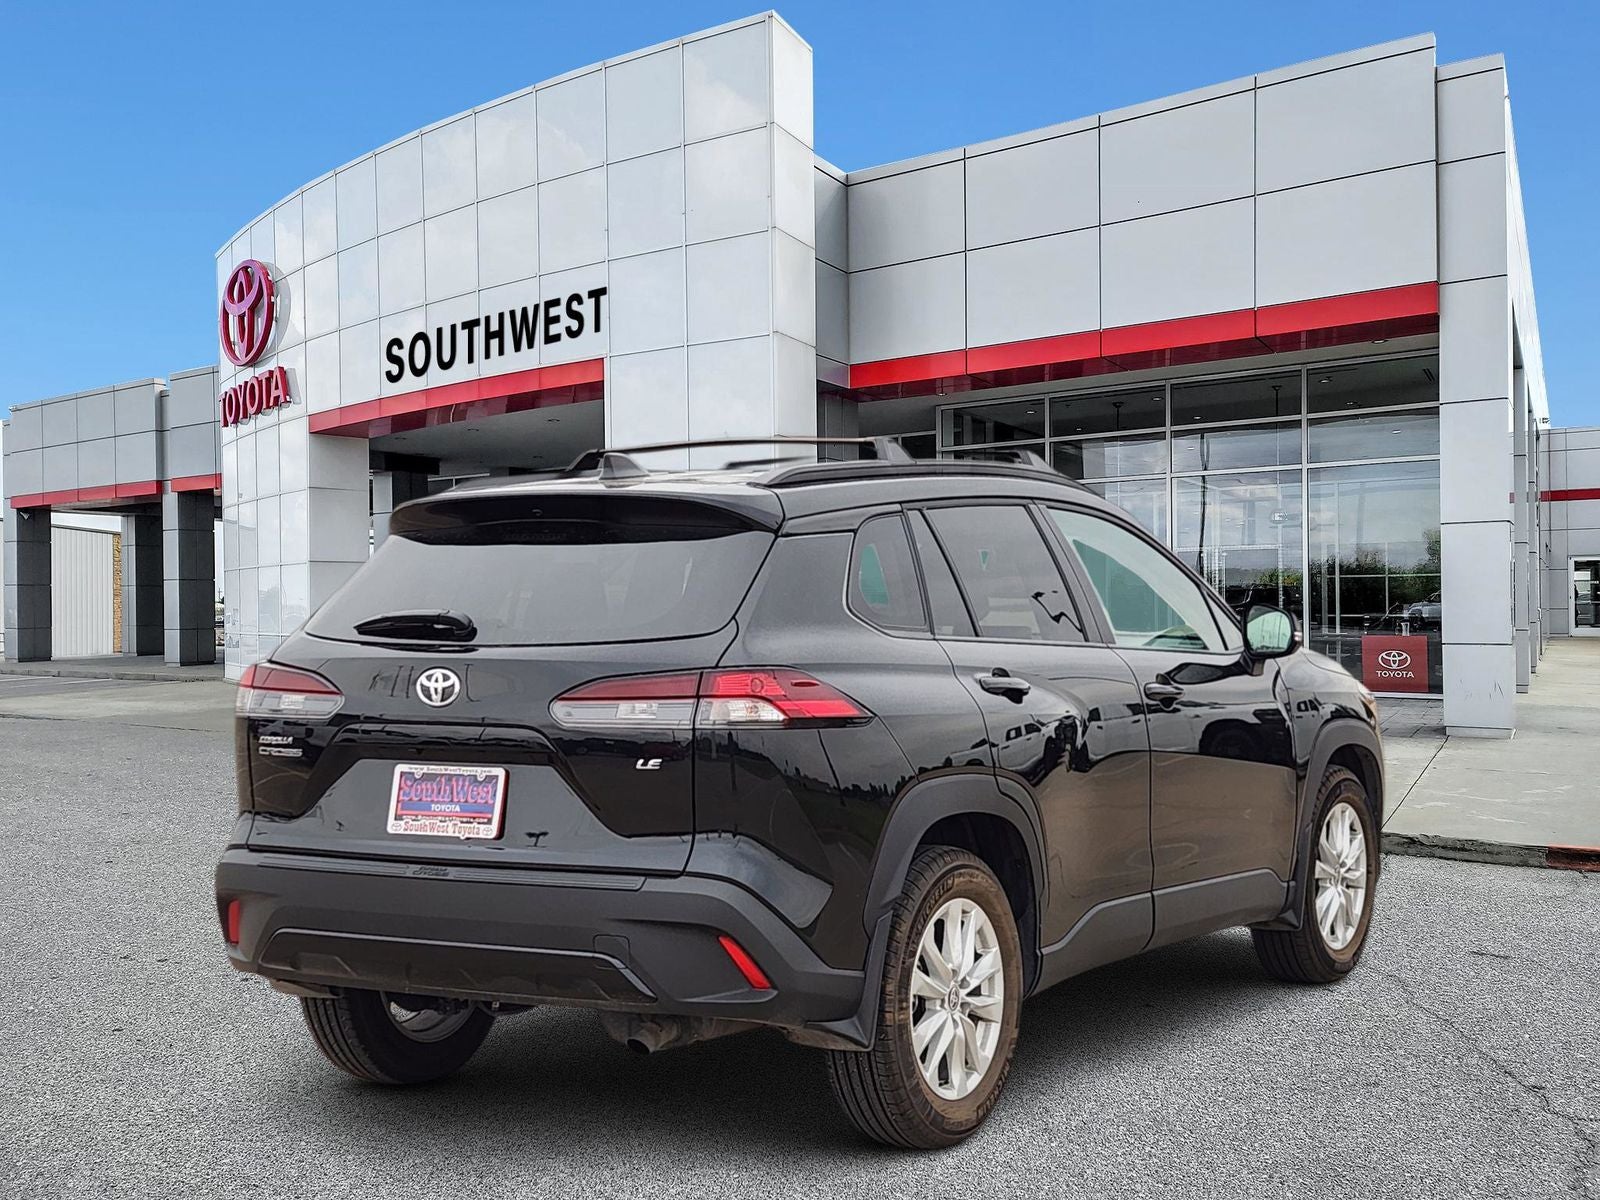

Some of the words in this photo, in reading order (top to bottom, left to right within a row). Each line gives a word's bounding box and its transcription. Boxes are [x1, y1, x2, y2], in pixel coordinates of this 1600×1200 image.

[385, 287, 607, 384] SOUTHWEST
[219, 366, 289, 427] TOYOTA
[1376, 670, 1415, 678] TOYOTA
[636, 758, 663, 770] LE
[431, 803, 461, 812] TOYOTA
[403, 821, 449, 834] SouthWest
[451, 823, 481, 837] Toyota
